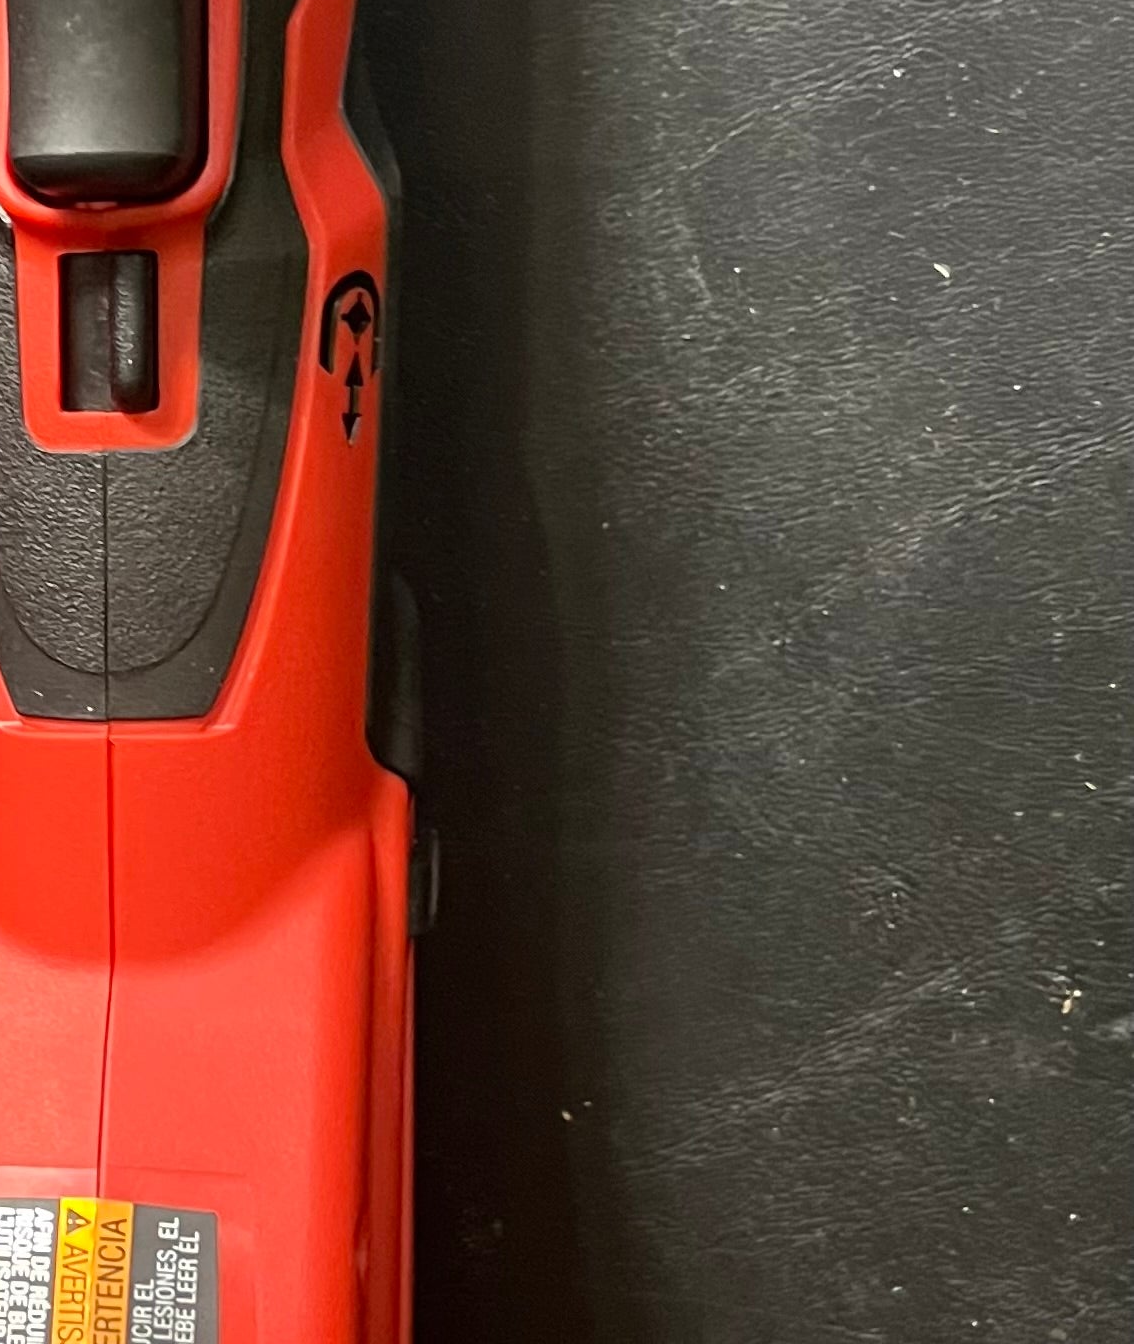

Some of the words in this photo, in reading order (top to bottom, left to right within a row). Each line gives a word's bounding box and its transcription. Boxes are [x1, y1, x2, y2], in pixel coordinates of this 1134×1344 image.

[32, 1208, 54, 1252] AFIN
[158, 1217, 180, 1239] EL
[11, 1209, 34, 1275] RISQUE
[30, 1256, 48, 1281] DE
[179, 1259, 198, 1303] LEER
[10, 1281, 29, 1306] DE
[135, 1279, 154, 1300] EL
